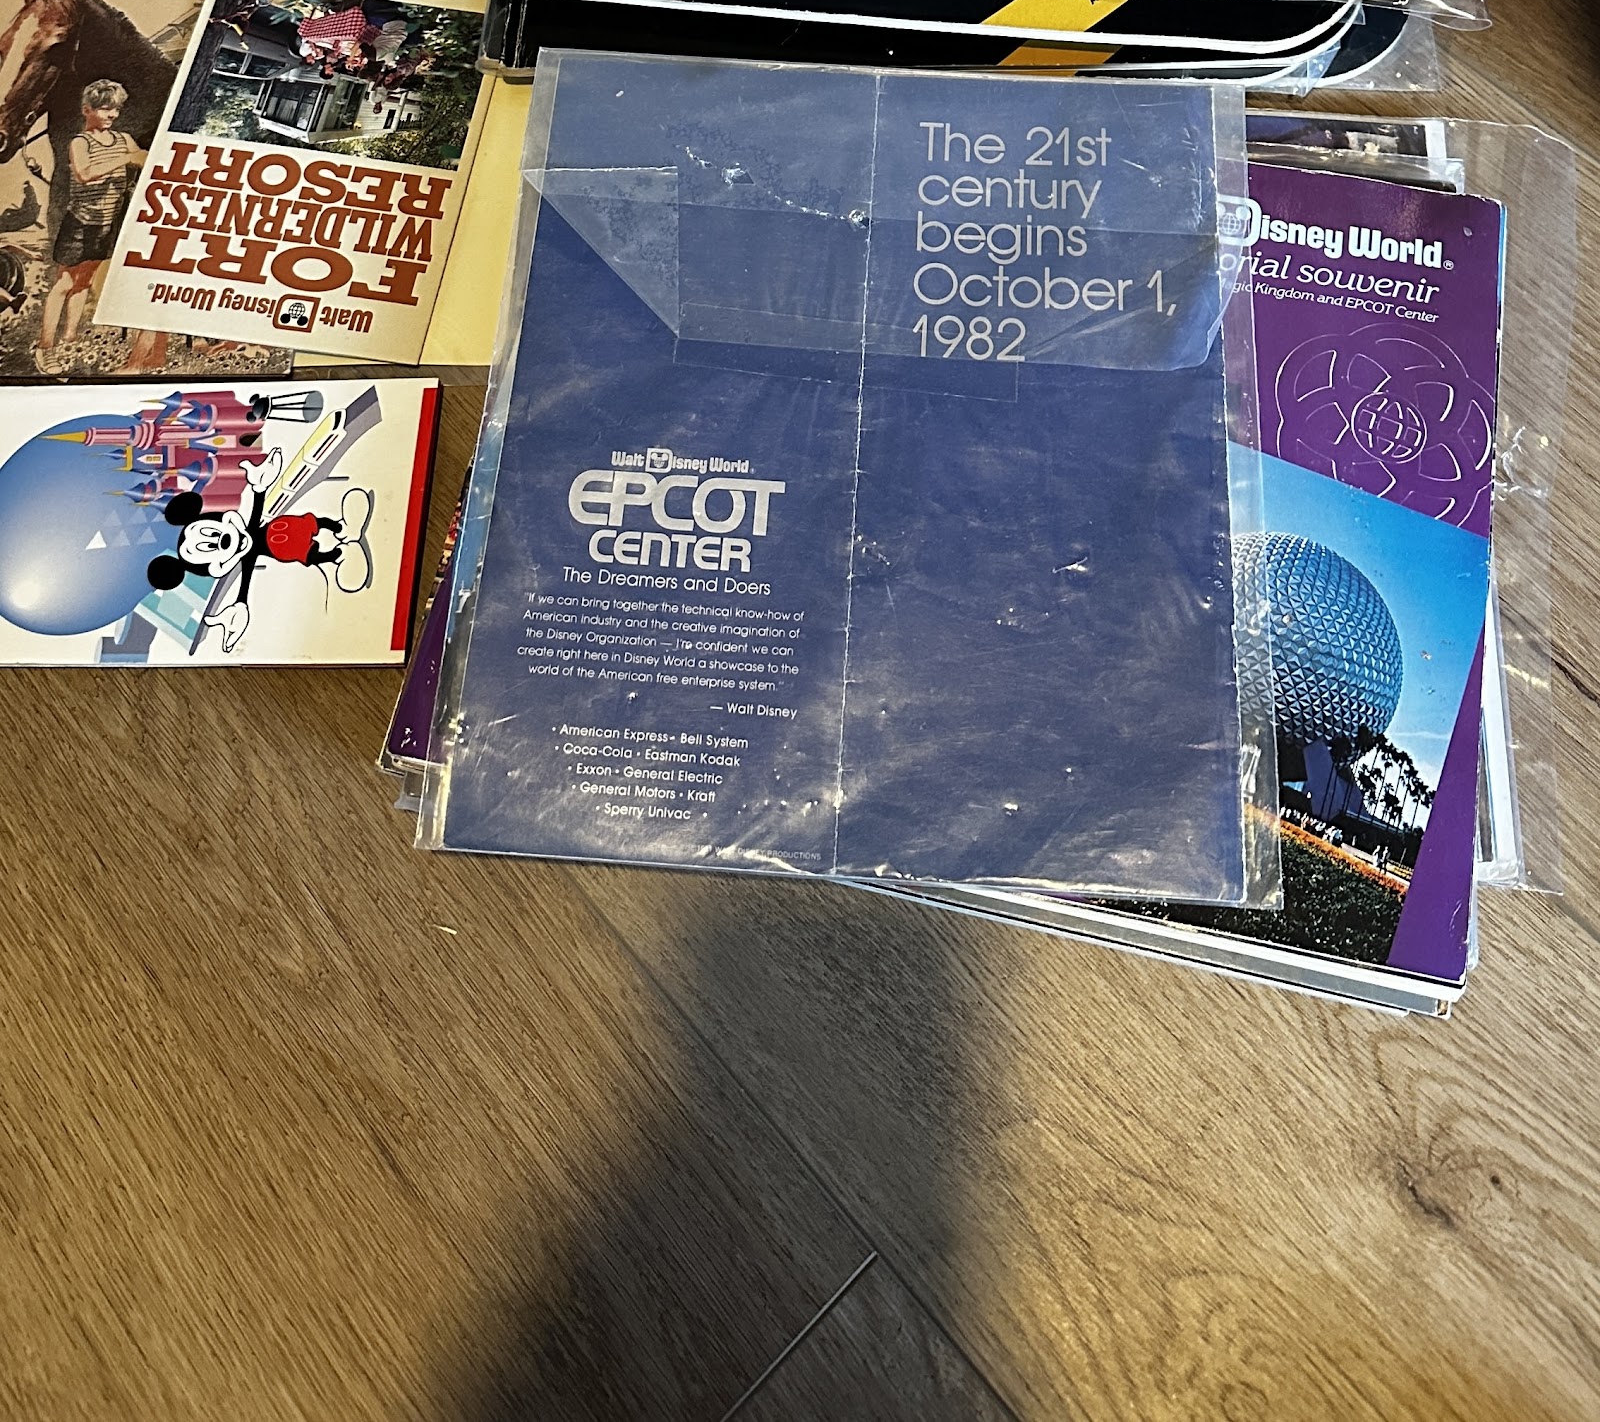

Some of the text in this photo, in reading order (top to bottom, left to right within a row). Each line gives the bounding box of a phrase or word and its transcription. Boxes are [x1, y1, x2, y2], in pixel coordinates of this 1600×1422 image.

[919, 122, 1112, 166] The 21st
[150, 141, 453, 220] RESORT
[918, 169, 1102, 219] century
[137, 181, 433, 262] WILDERNESS
[916, 211, 1088, 265] begins
[123, 226, 428, 307] FORT
[913, 262, 1177, 316] October 1,
[1295, 262, 1440, 305] souvenir
[218, 288, 321, 334] Disney
[1254, 282, 1315, 302] Kingdom
[1316, 292, 1344, 307] and
[1345, 296, 1395, 316] EPCOT
[1395, 304, 1440, 324] Center
[319, 306, 374, 334] Walt
[912, 314, 1026, 363] 1982
[611, 447, 750, 474] Walt Disney World
[568, 469, 786, 536] EPCOT
[588, 529, 752, 573] CENTER
[562, 566, 772, 596] The Dreamers and Doers
[537, 595, 554, 605] we
[557, 596, 579, 606] can
[581, 596, 610, 610] bring
[613, 599, 659, 613] together
[661, 601, 679, 614] the
[682, 603, 733, 618] technical
[735, 607, 791, 621] know-how
[794, 611, 805, 622] of
[522, 609, 801, 639] American industry and the creative imagination of
[525, 627, 544, 639] the
[546, 628, 583, 643] Disney
[585, 631, 657, 647] Organization
[695, 640, 749, 654] confident
[751, 645, 769, 655] we
[771, 646, 794, 656] can
[516, 645, 800, 675] create right here in Disney World a showcase to the
[528, 664, 560, 676] world
[562, 665, 574, 677] of
[576, 666, 595, 678] the
[597, 668, 653, 683] American
[656, 672, 679, 684] free
[681, 675, 736, 690] enterprise
[726, 702, 798, 720] Walt Disney
[559, 723, 750, 750] American Express Bell System
[562, 742, 741, 768] Coca-Cola Eastman Kodak
[576, 763, 724, 786] Exxon General Electric
[579, 781, 717, 803] General Motors Kraft
[603, 802, 692, 821] Sperry Univac
[767, 849, 822, 861] PRODUCTIONS
